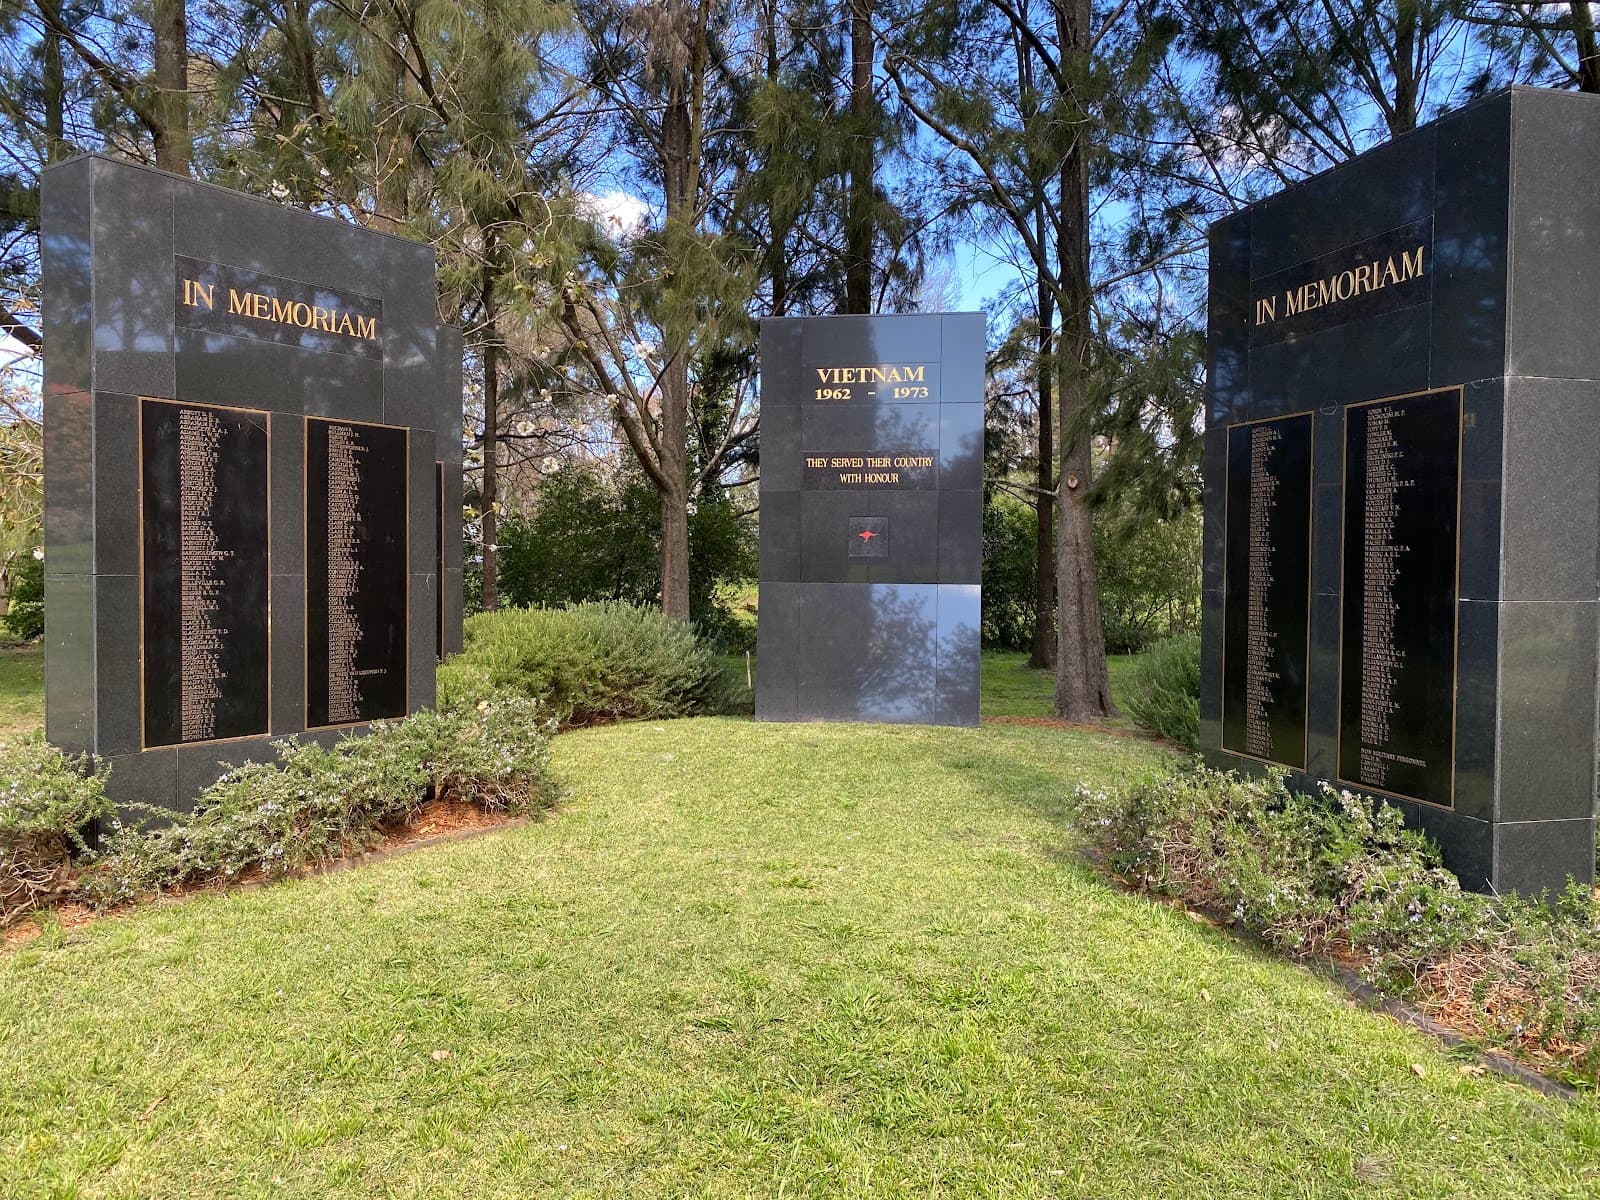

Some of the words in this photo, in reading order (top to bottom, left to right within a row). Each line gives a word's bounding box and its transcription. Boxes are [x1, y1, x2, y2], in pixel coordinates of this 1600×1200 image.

[1255, 295, 1277, 326] IN
[1284, 245, 1425, 318] MEMORIAM
[183, 279, 215, 311] IN
[227, 288, 377, 341] MEMORIAM
[815, 366, 925, 384] VIETNAM
[815, 388, 851, 401] 1962
[893, 386, 929, 399] 1973
[806, 457, 828, 468] THEY
[831, 457, 864, 468] SERVED
[866, 456, 891, 468] THEIR
[894, 456, 934, 468] COUNTRY
[840, 473, 862, 484] WITH
[864, 473, 899, 484] HONOUR
